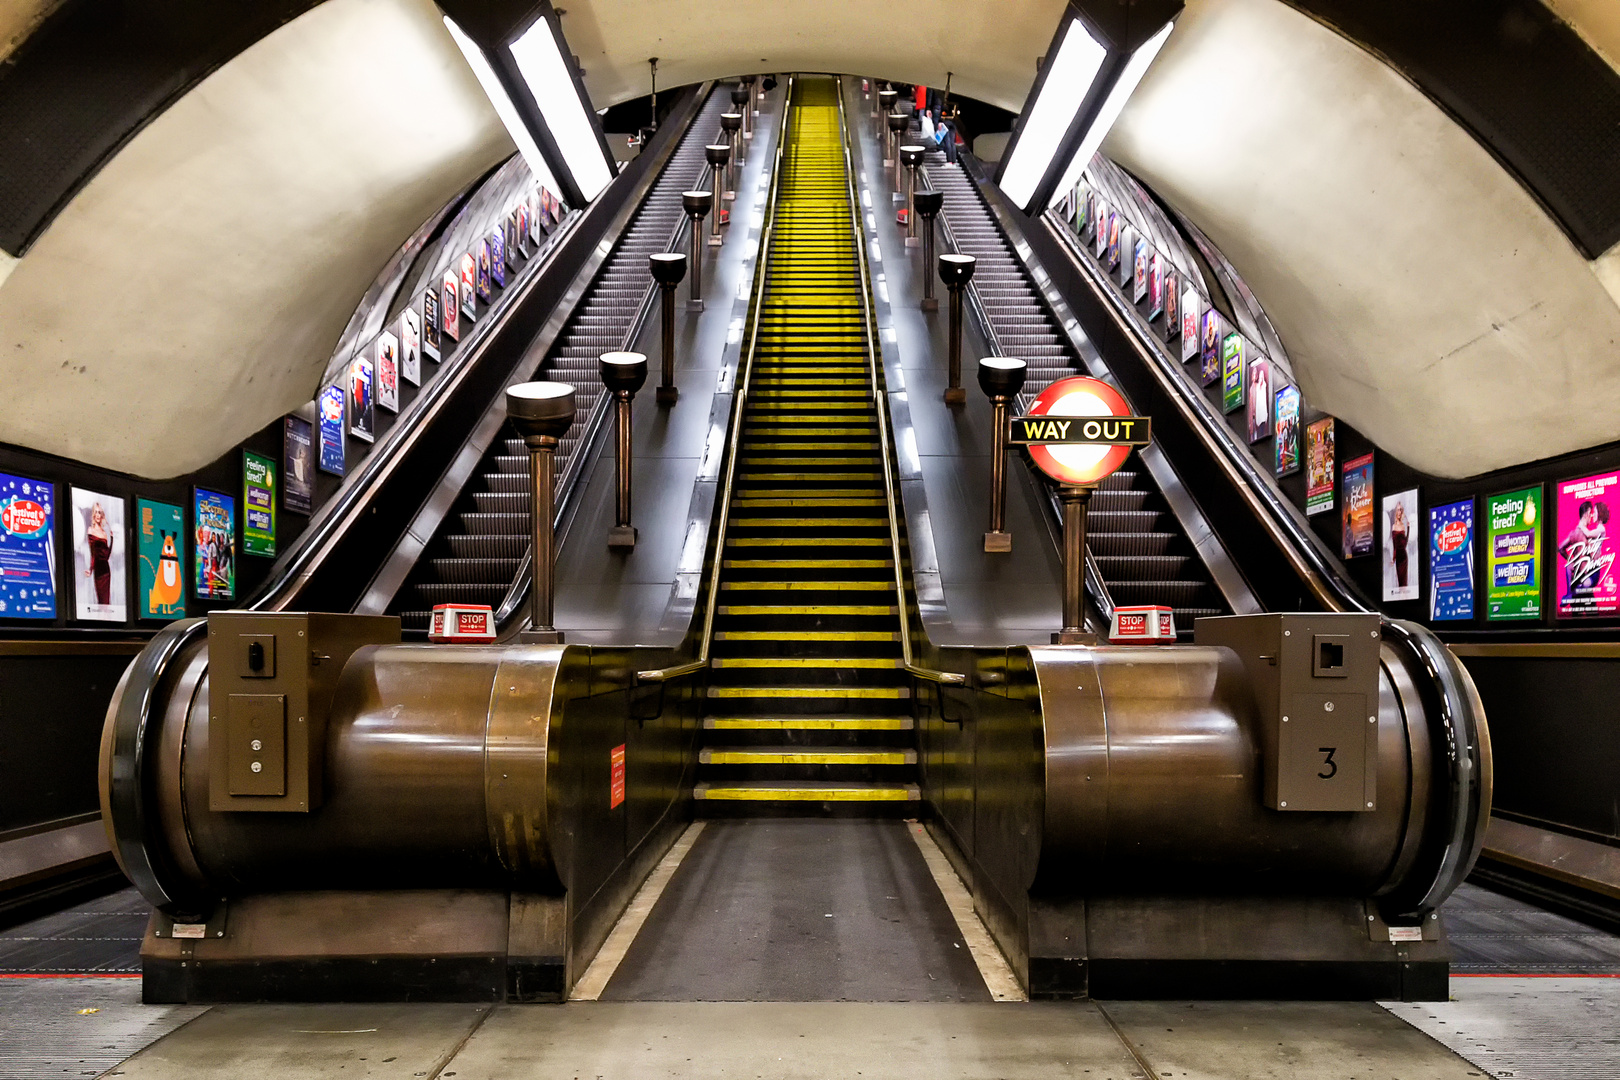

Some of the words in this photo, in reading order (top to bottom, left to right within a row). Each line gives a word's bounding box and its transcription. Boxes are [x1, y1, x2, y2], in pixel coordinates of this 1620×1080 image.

[1024, 421, 1071, 439] WAY
[1083, 421, 1134, 439] OUT
[246, 458, 266, 476] Feeling
[246, 471, 262, 483] tired?
[1492, 499, 1523, 515] Feeling
[1493, 513, 1517, 530] tired?
[1498, 535, 1529, 548] wellwoman
[1508, 544, 1528, 553] ENERGY
[1564, 533, 1610, 567] Dirty
[1570, 547, 1616, 587] Dancing
[1507, 575, 1527, 584] ENERGY
[461, 614, 484, 624] STOP
[1121, 616, 1143, 625] STOP
[1317, 747, 1337, 779] 3
